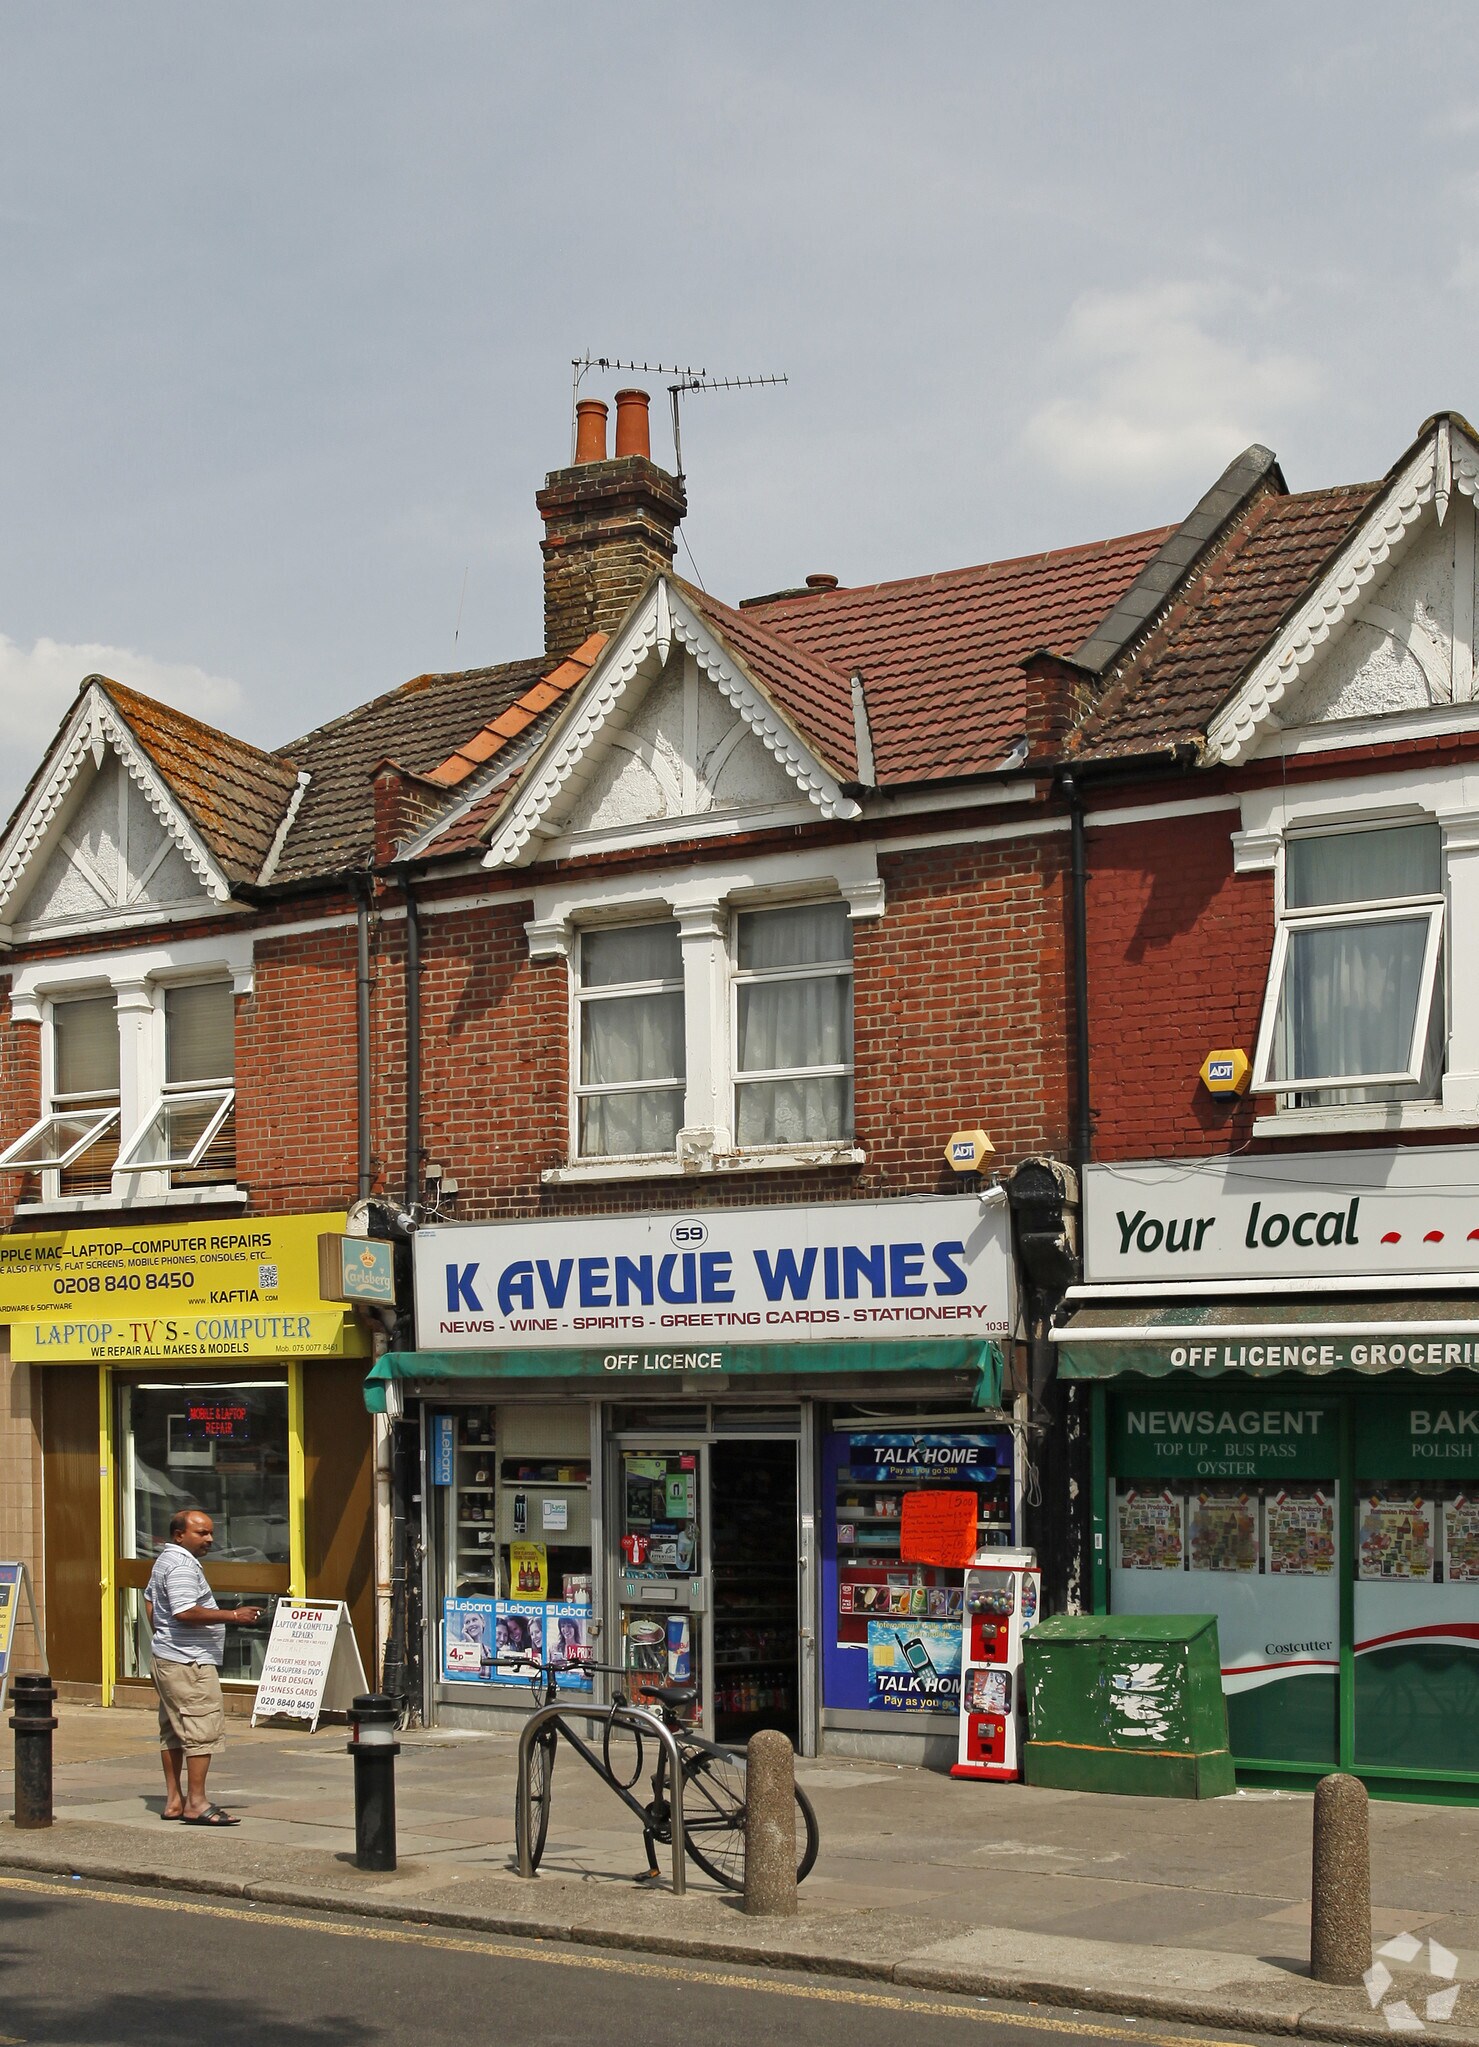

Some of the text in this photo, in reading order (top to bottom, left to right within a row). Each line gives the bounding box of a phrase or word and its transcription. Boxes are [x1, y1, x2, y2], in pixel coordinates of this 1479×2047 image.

[1210, 1062, 1232, 1083] ADT
[953, 1144, 974, 1160] ADT
[1115, 1196, 1360, 1254] Your local
[676, 1227, 705, 1245] 59
[0, 1248, 32, 1262] PPLE
[210, 1233, 272, 1250] REPAIRS
[7, 1264, 27, 1274] ALSO
[29, 1264, 41, 1272] FIX
[65, 1260, 84, 1271] FLAT
[86, 1258, 126, 1270] SCREENS,
[128, 1256, 159, 1268] MOBILE
[161, 1255, 198, 1267] PHONES,
[200, 1251, 248, 1264] CONSOLES,
[53, 1271, 195, 1295] 0208 840 8450
[345, 1264, 391, 1291] Carlsberg
[446, 1239, 969, 1318] K AVENUE WINES
[210, 1289, 260, 1304] KAFTIA
[0, 1305, 30, 1313] ARDWARE
[37, 1302, 73, 1311] SOFTWARE
[440, 1321, 495, 1333] NEWS
[510, 1319, 558, 1332] WINE
[572, 1316, 645, 1330] SPIRITS
[660, 1312, 761, 1329] GREETING
[766, 1309, 841, 1324] CARDS
[853, 1304, 988, 1322] STATIONERY
[35, 1324, 113, 1345] LAPTOP
[195, 1316, 311, 1341] COMPUTER
[985, 1322, 1009, 1331] 103B
[91, 1342, 249, 1357] WE REPAIR ALL MAKES & MODELS
[275, 1345, 290, 1353] Mob.
[603, 1352, 723, 1374] OFF LICENCE
[1169, 1347, 1217, 1367] OFF
[190, 1407, 214, 1420] MOBILE
[221, 1407, 246, 1420] LAPTOP
[205, 1422, 233, 1434] REPAIR
[1126, 1411, 1325, 1435] NEWSAGENT
[874, 1447, 979, 1464] TALK HOME
[1154, 1442, 1184, 1456] TOP
[1188, 1442, 1208, 1456] UP
[1225, 1442, 1255, 1457] BUS
[1259, 1442, 1297, 1457] PASS
[1411, 1443, 1472, 1457] POLISH
[441, 1432, 453, 1483] Lebara
[890, 1467, 904, 1475] Pay
[932, 1467, 942, 1475] go
[944, 1466, 958, 1474] SIM
[1197, 1461, 1256, 1475] OYSTER
[455, 1602, 492, 1613] Lebara
[505, 1604, 543, 1615] Lebara
[291, 1611, 323, 1621] OPEN
[275, 1621, 298, 1629] LAPTOP
[303, 1622, 333, 1631] COMPUTER
[291, 1631, 314, 1639] REPAIRS
[1265, 1641, 1333, 1656] Costcutter
[271, 1675, 315, 1685] WEB DESIGN
[878, 1675, 921, 1693] TALK
[295, 1688, 318, 1697] CARDS
[260, 1697, 315, 1710] 020 8840 8450
[884, 1695, 956, 1709] Pay as you go
